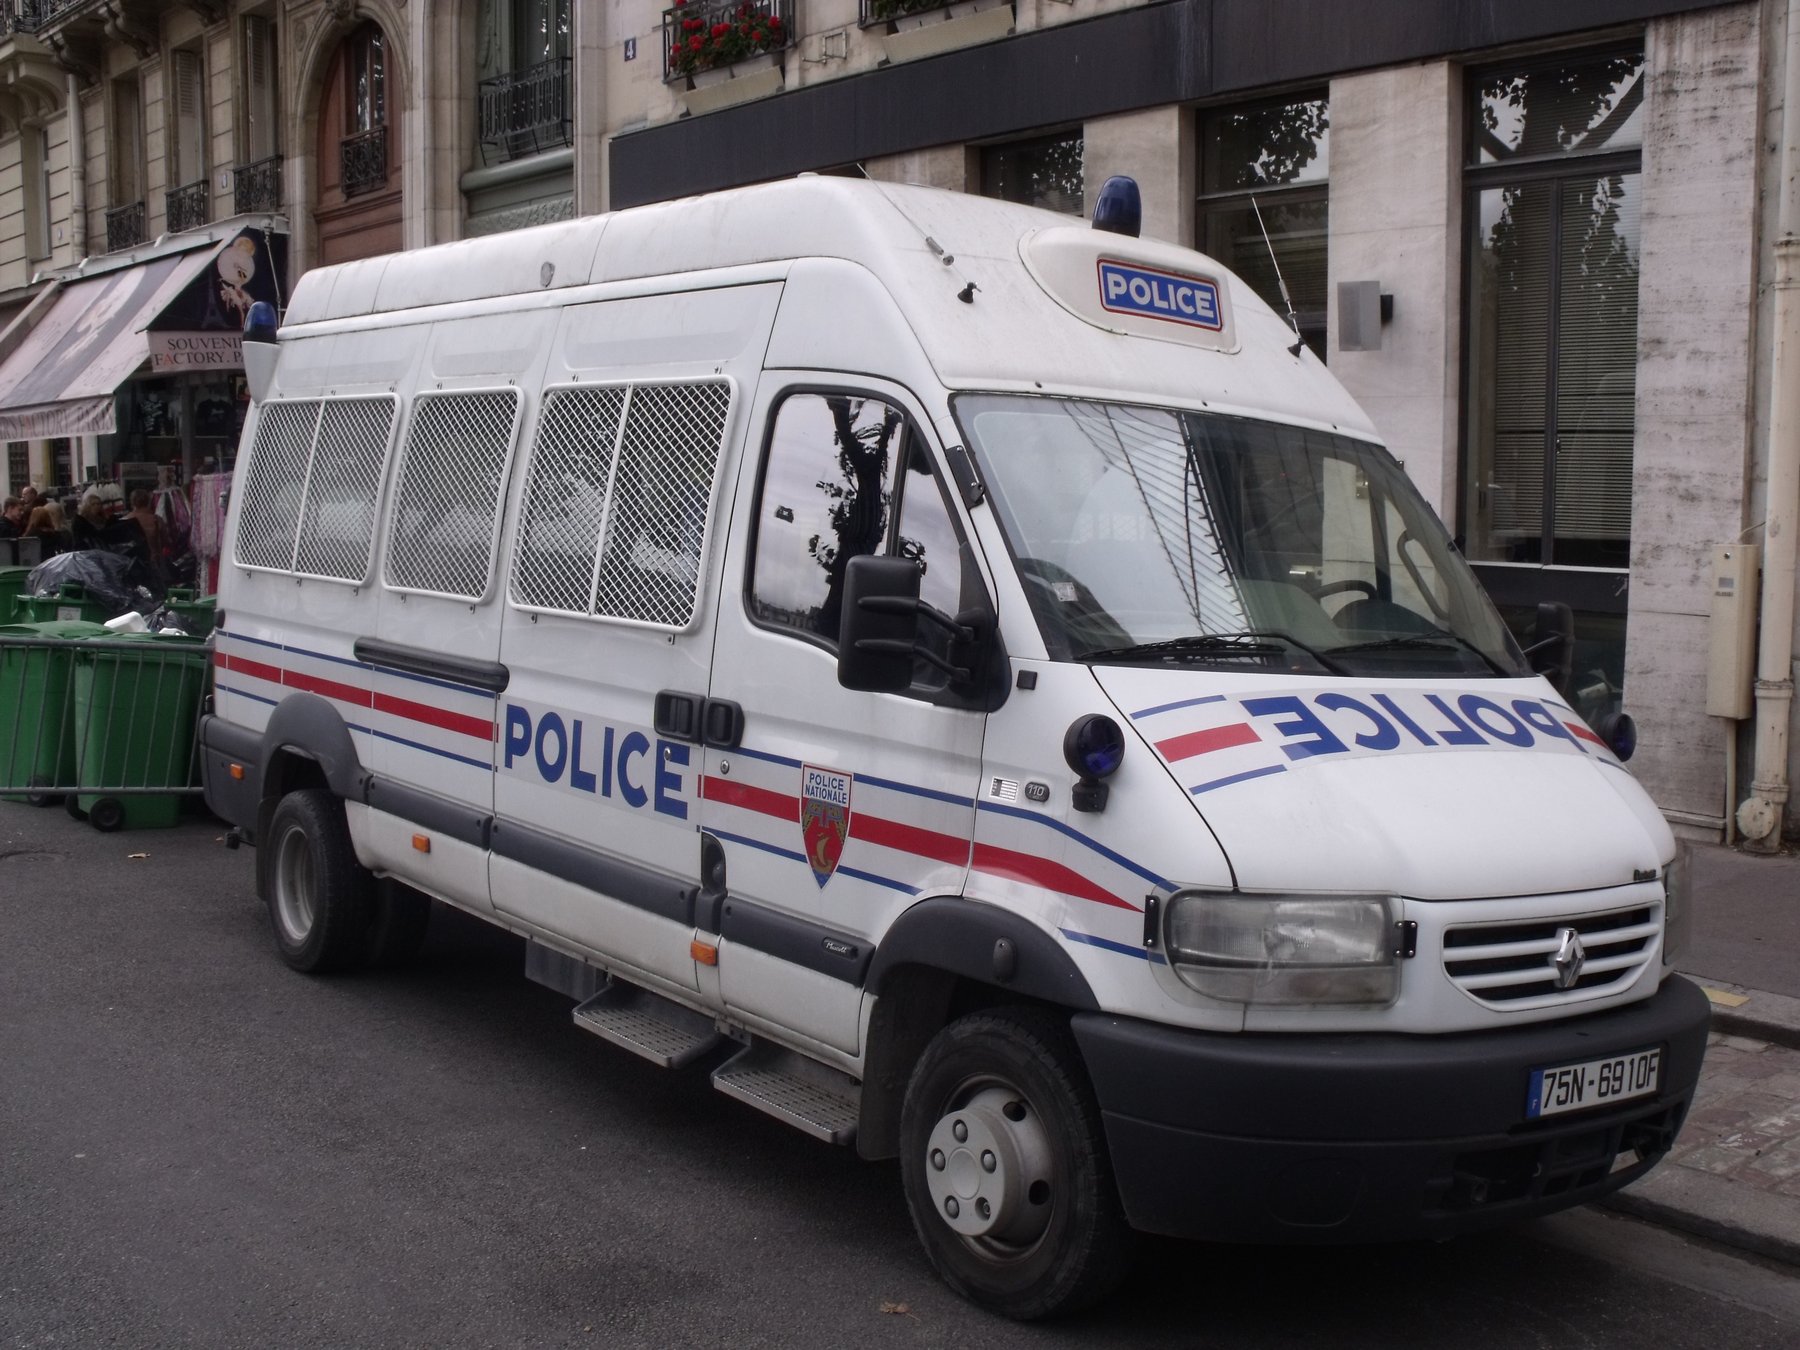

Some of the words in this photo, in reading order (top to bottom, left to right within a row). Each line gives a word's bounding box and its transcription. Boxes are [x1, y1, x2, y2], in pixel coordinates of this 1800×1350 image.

[626, 40, 634, 59] 4
[1106, 272, 1214, 318] POLICE
[505, 704, 690, 820] POLICE
[809, 772, 844, 791] POLICE
[1028, 784, 1045, 797] 110
[805, 784, 847, 804] NATIONALE
[1543, 1053, 1659, 1109] 75N-6910F
